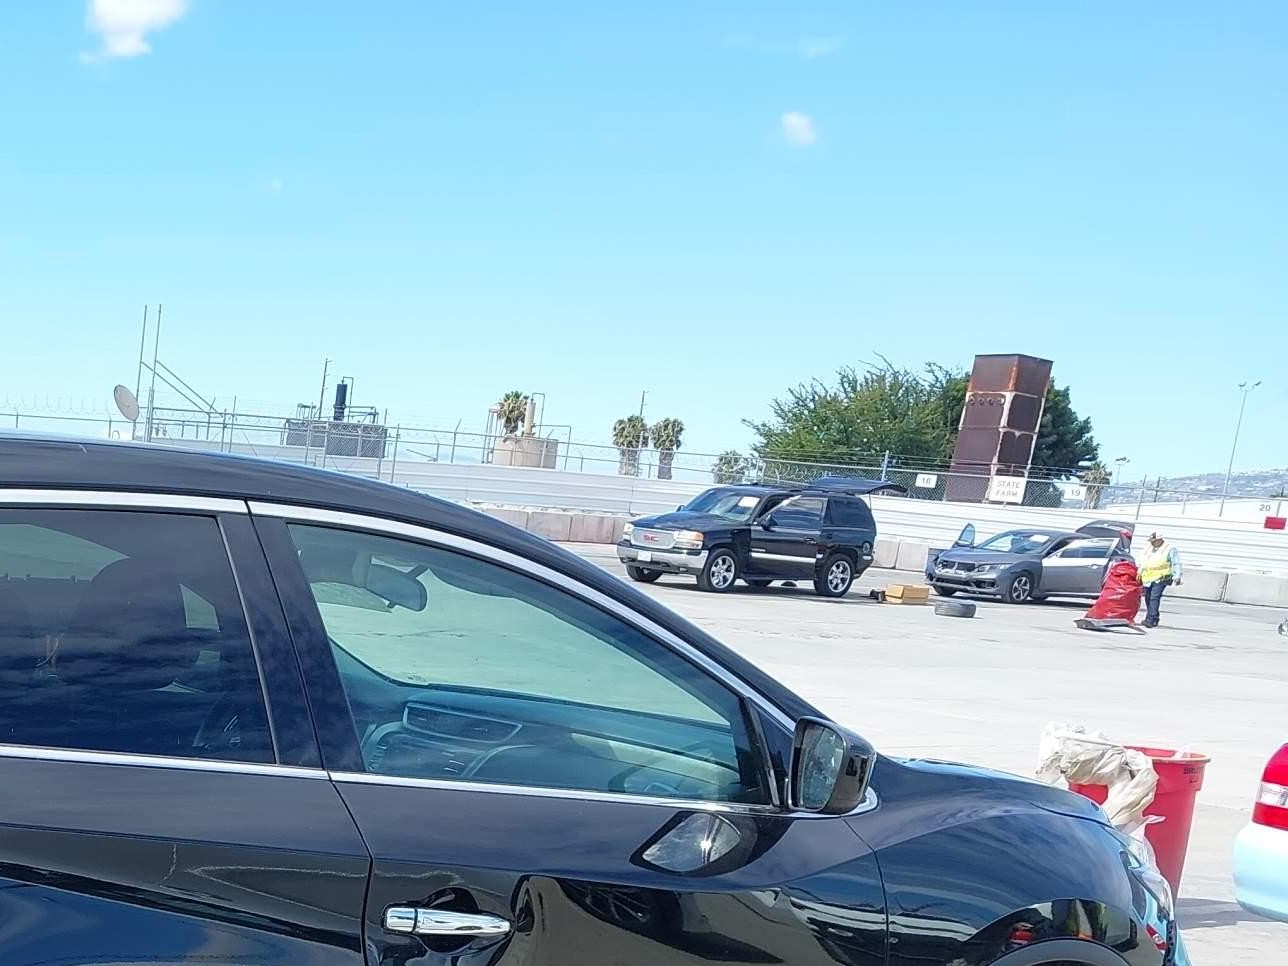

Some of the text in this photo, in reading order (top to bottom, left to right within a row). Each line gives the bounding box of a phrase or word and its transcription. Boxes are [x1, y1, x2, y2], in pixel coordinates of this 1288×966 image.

[996, 480, 1021, 489] STATE
[1071, 489, 1081, 497] 19
[1259, 503, 1271, 512] 20
